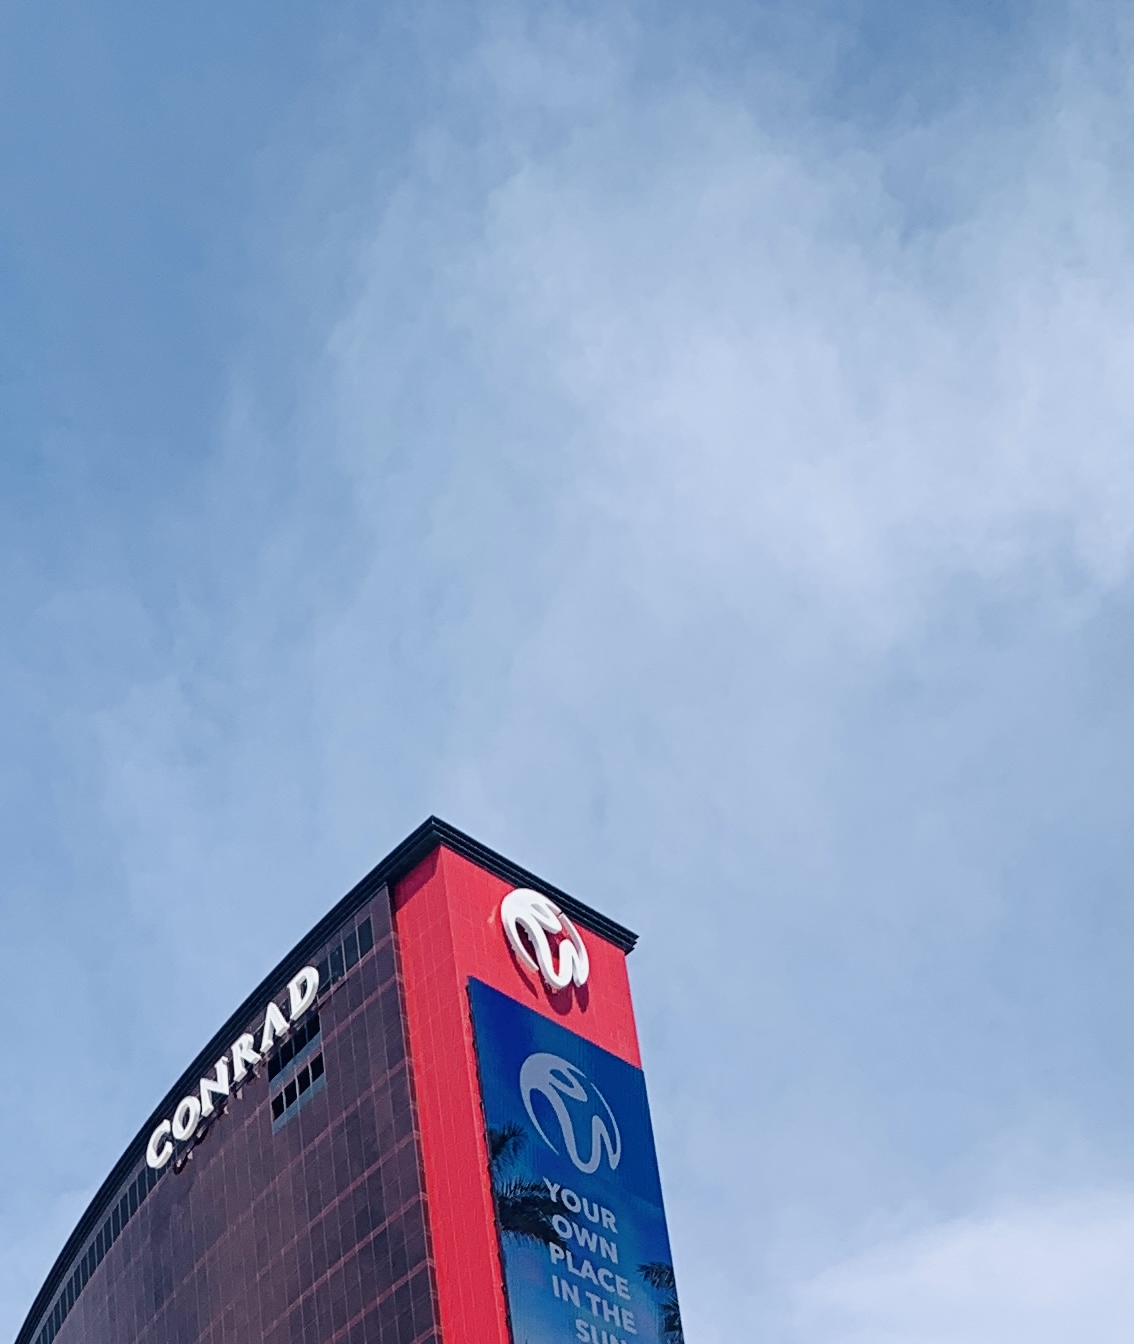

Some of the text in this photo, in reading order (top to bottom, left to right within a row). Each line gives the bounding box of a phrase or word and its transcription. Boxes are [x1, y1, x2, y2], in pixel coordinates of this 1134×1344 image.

[145, 965, 319, 1170] CONRAD
[542, 1176, 618, 1234] YOUR
[552, 1213, 619, 1265] OWN
[549, 1241, 631, 1301] PLACE
[552, 1274, 638, 1336] IN THE
